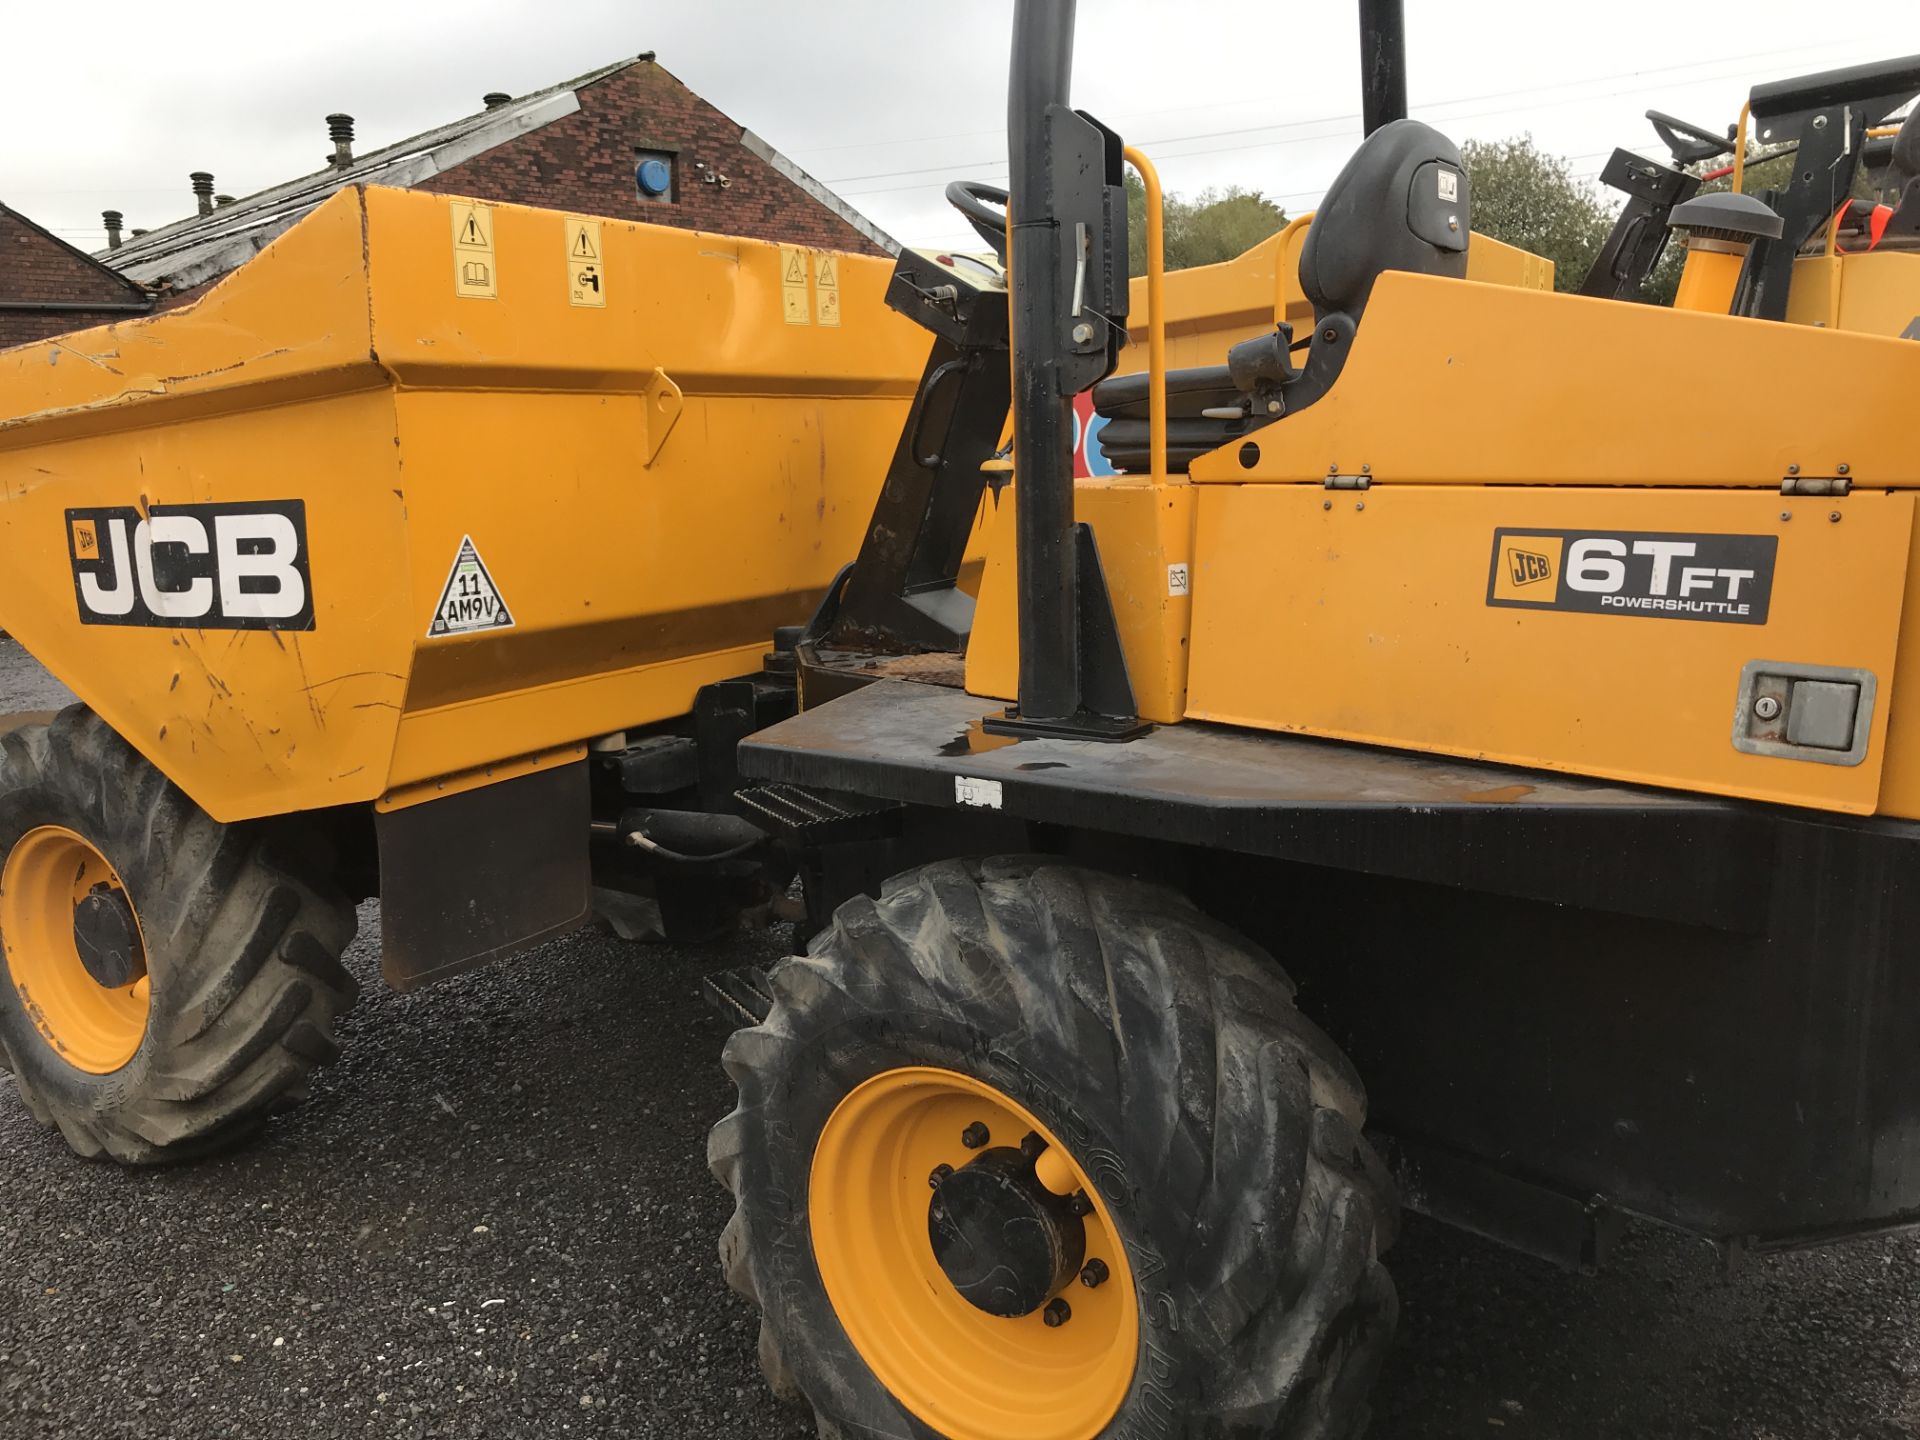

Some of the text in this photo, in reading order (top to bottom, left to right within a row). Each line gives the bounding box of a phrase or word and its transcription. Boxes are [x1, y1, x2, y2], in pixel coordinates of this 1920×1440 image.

[79, 530, 94, 549] JCB
[79, 513, 305, 618] JCB
[1514, 553, 1549, 583] JCB
[459, 573, 481, 597] 11
[447, 596, 494, 622] AM9V
[1601, 595, 1750, 615] POWERSHUTTLE
